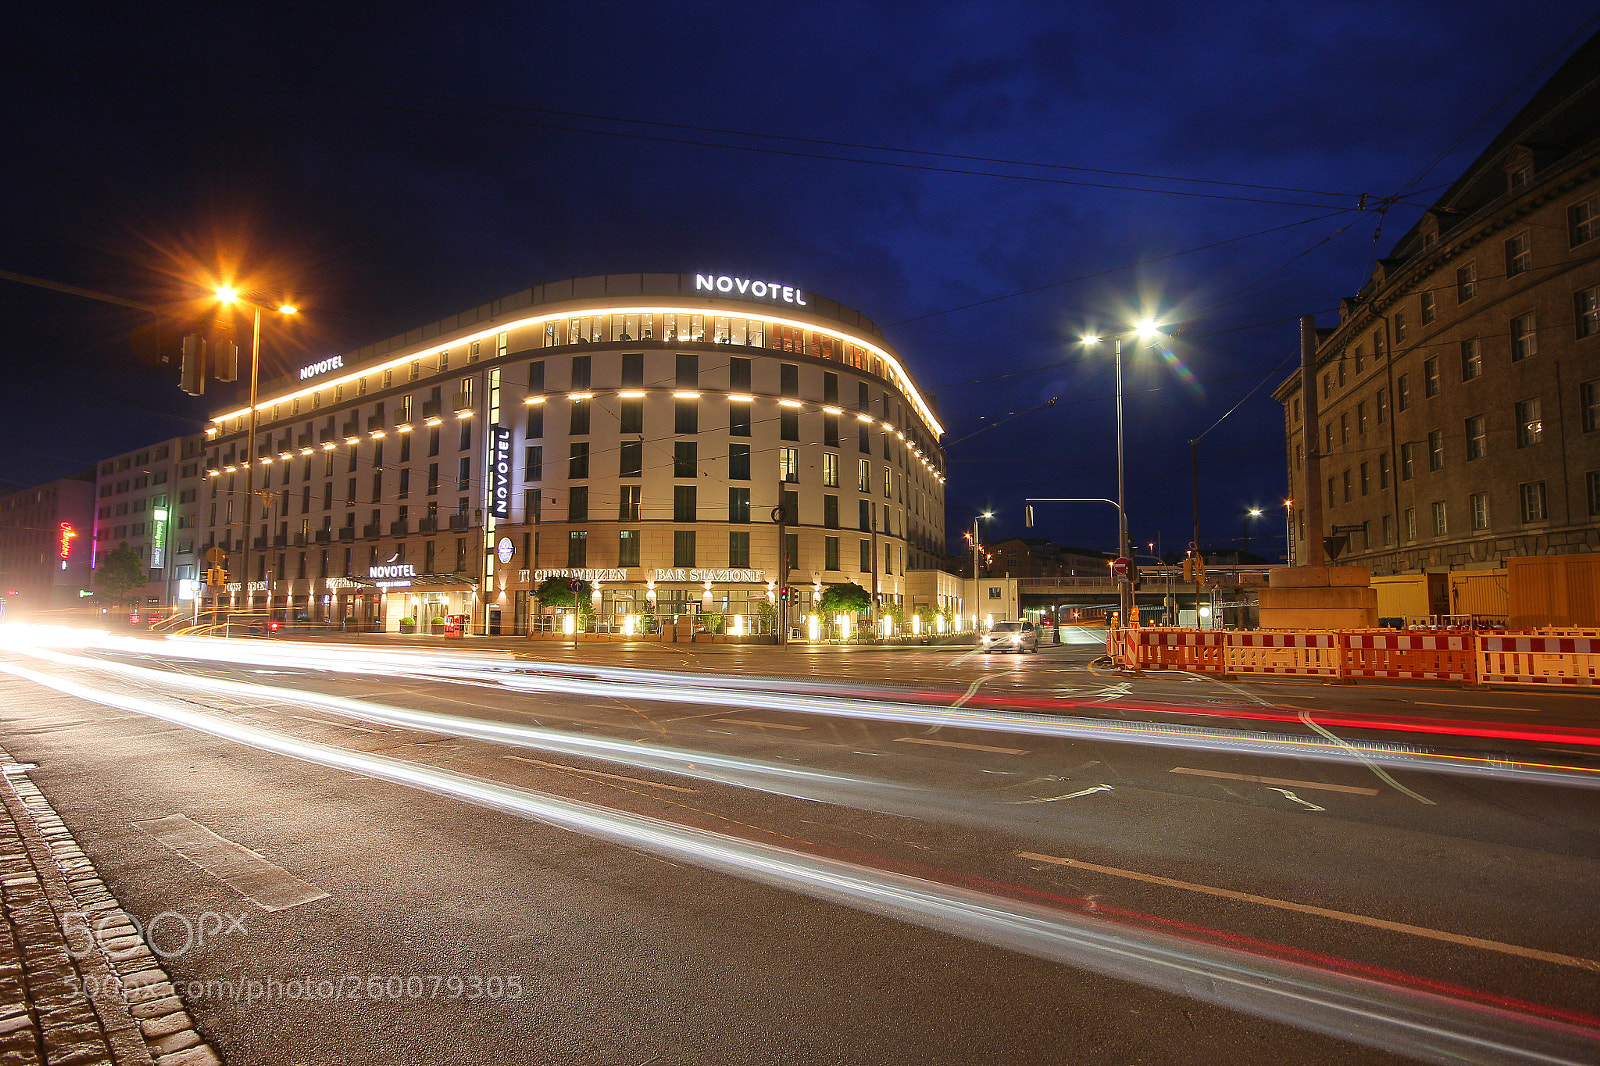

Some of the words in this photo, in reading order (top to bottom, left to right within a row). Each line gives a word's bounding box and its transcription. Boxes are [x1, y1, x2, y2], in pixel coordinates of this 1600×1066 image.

[696, 273, 807, 306] NOVOTEL
[300, 354, 344, 380] NOVOTEL
[496, 430, 510, 513] NOVOTEL
[155, 521, 164, 540] Holiday
[369, 564, 416, 579] NOVOTEL
[571, 568, 628, 581] WEIZEN
[655, 568, 686, 582] BAR
[689, 569, 763, 582] STAZIONE
